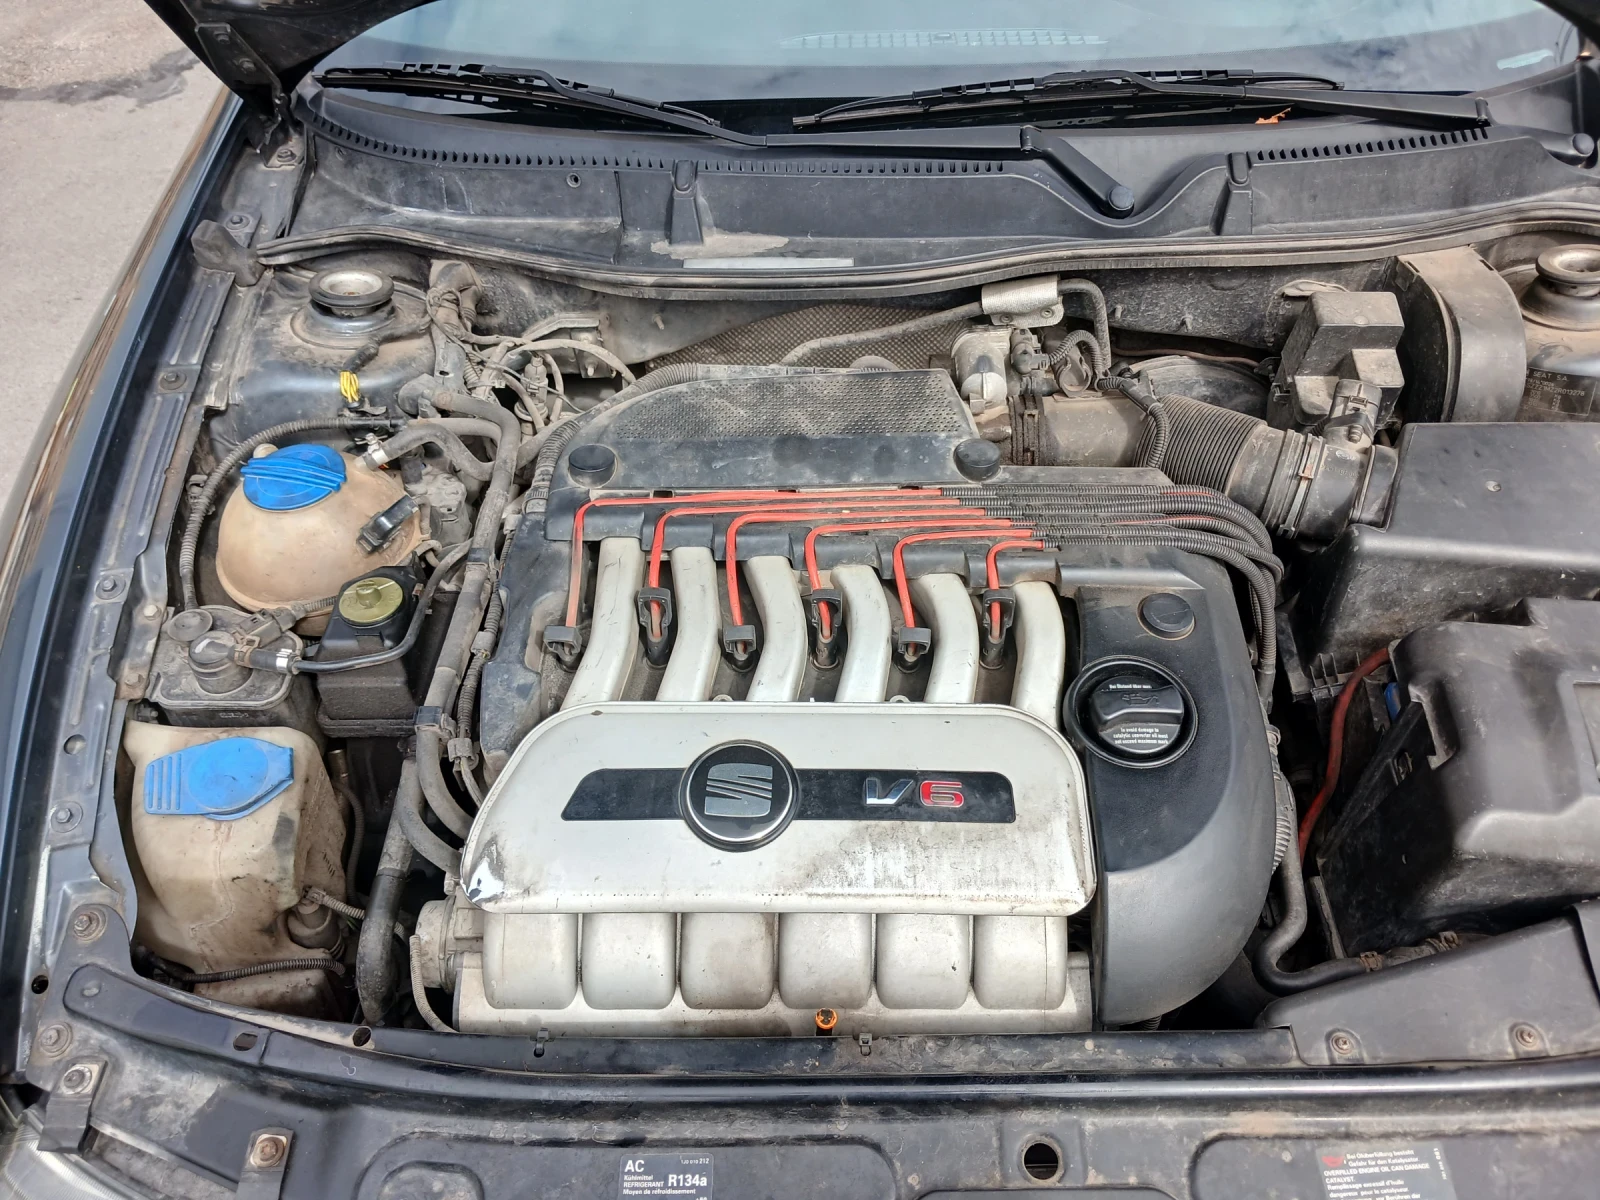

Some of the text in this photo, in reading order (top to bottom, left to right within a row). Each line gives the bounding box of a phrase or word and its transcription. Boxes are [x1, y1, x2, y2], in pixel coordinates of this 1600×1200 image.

[1533, 370, 1552, 379] SEAT
[865, 778, 964, 807] V6
[624, 1160, 645, 1172] AC
[668, 1174, 707, 1187] R134a
